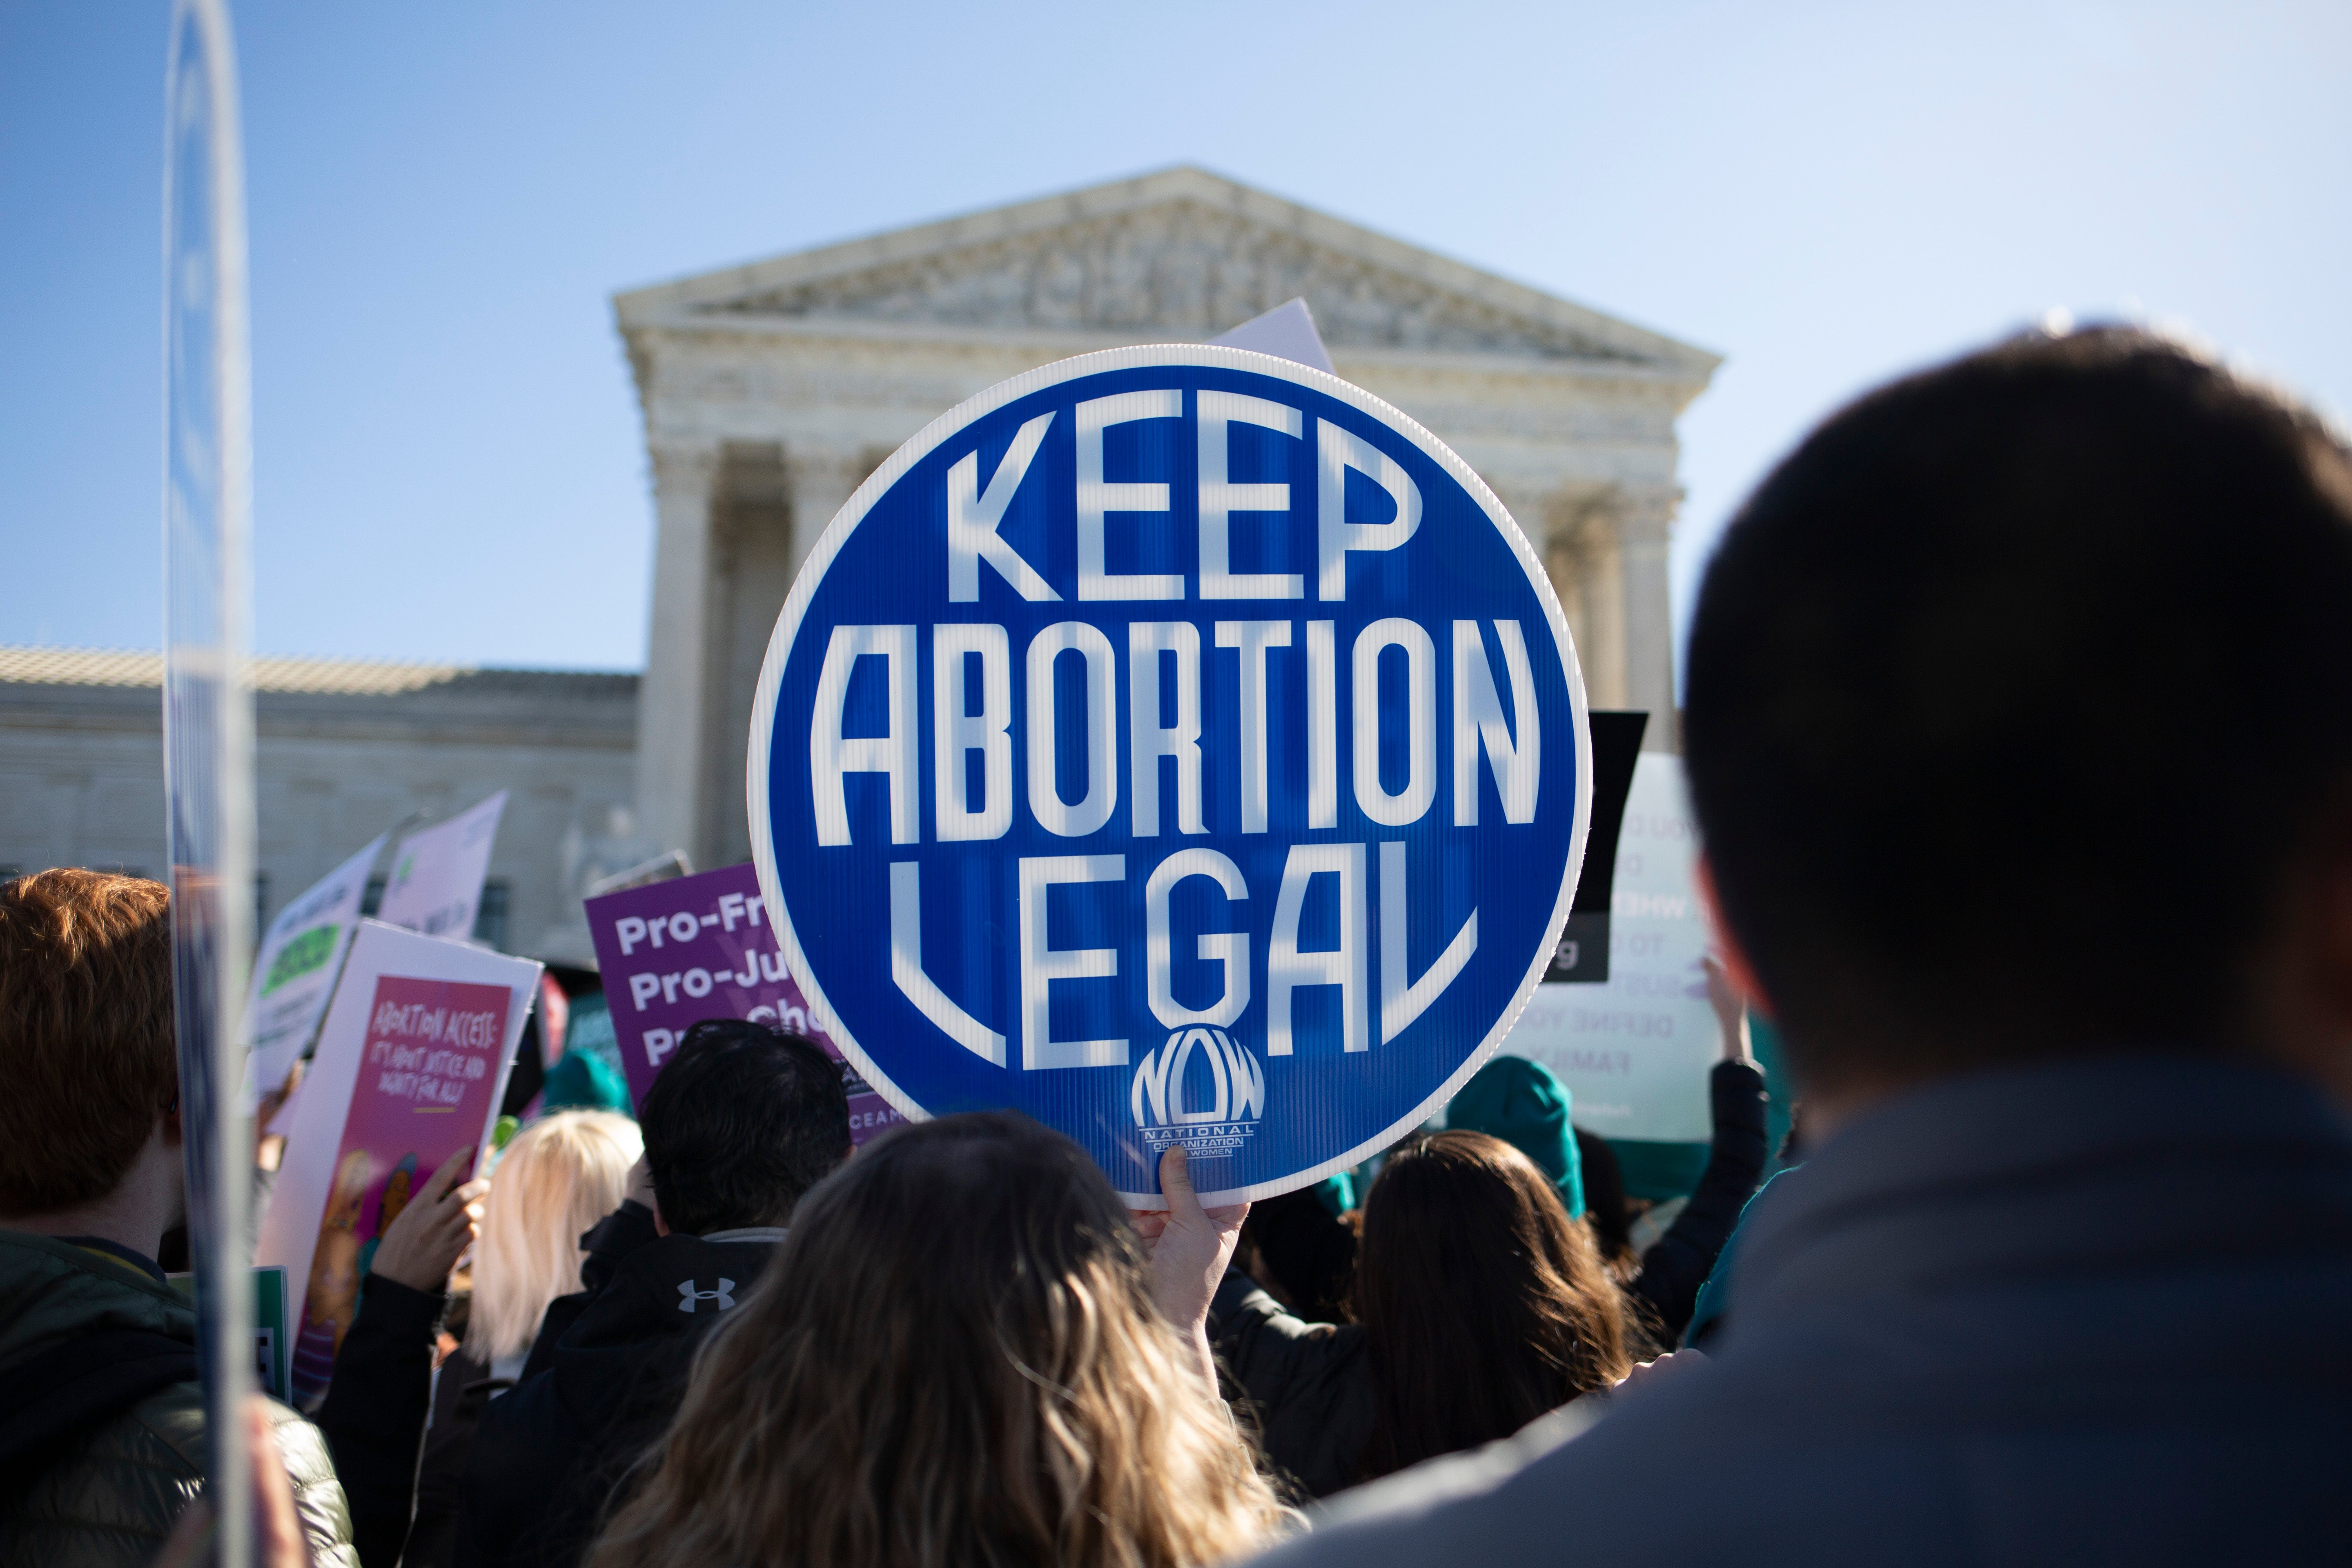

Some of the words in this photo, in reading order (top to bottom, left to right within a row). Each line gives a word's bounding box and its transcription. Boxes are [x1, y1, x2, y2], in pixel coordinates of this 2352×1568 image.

[947, 388, 1423, 602] KEEP
[810, 617, 1541, 847] ABORTION
[615, 893, 763, 956] Pro-Fr
[889, 841, 1478, 1071] LEGAL
[629, 948, 790, 1011] Pro-Ju
[1131, 1028, 1265, 1127] NOW
[1145, 1125, 1254, 1140] NATIONAL
[1153, 1137, 1244, 1150] ORANIZATION
[1190, 1148, 1232, 1157] WOMEN
